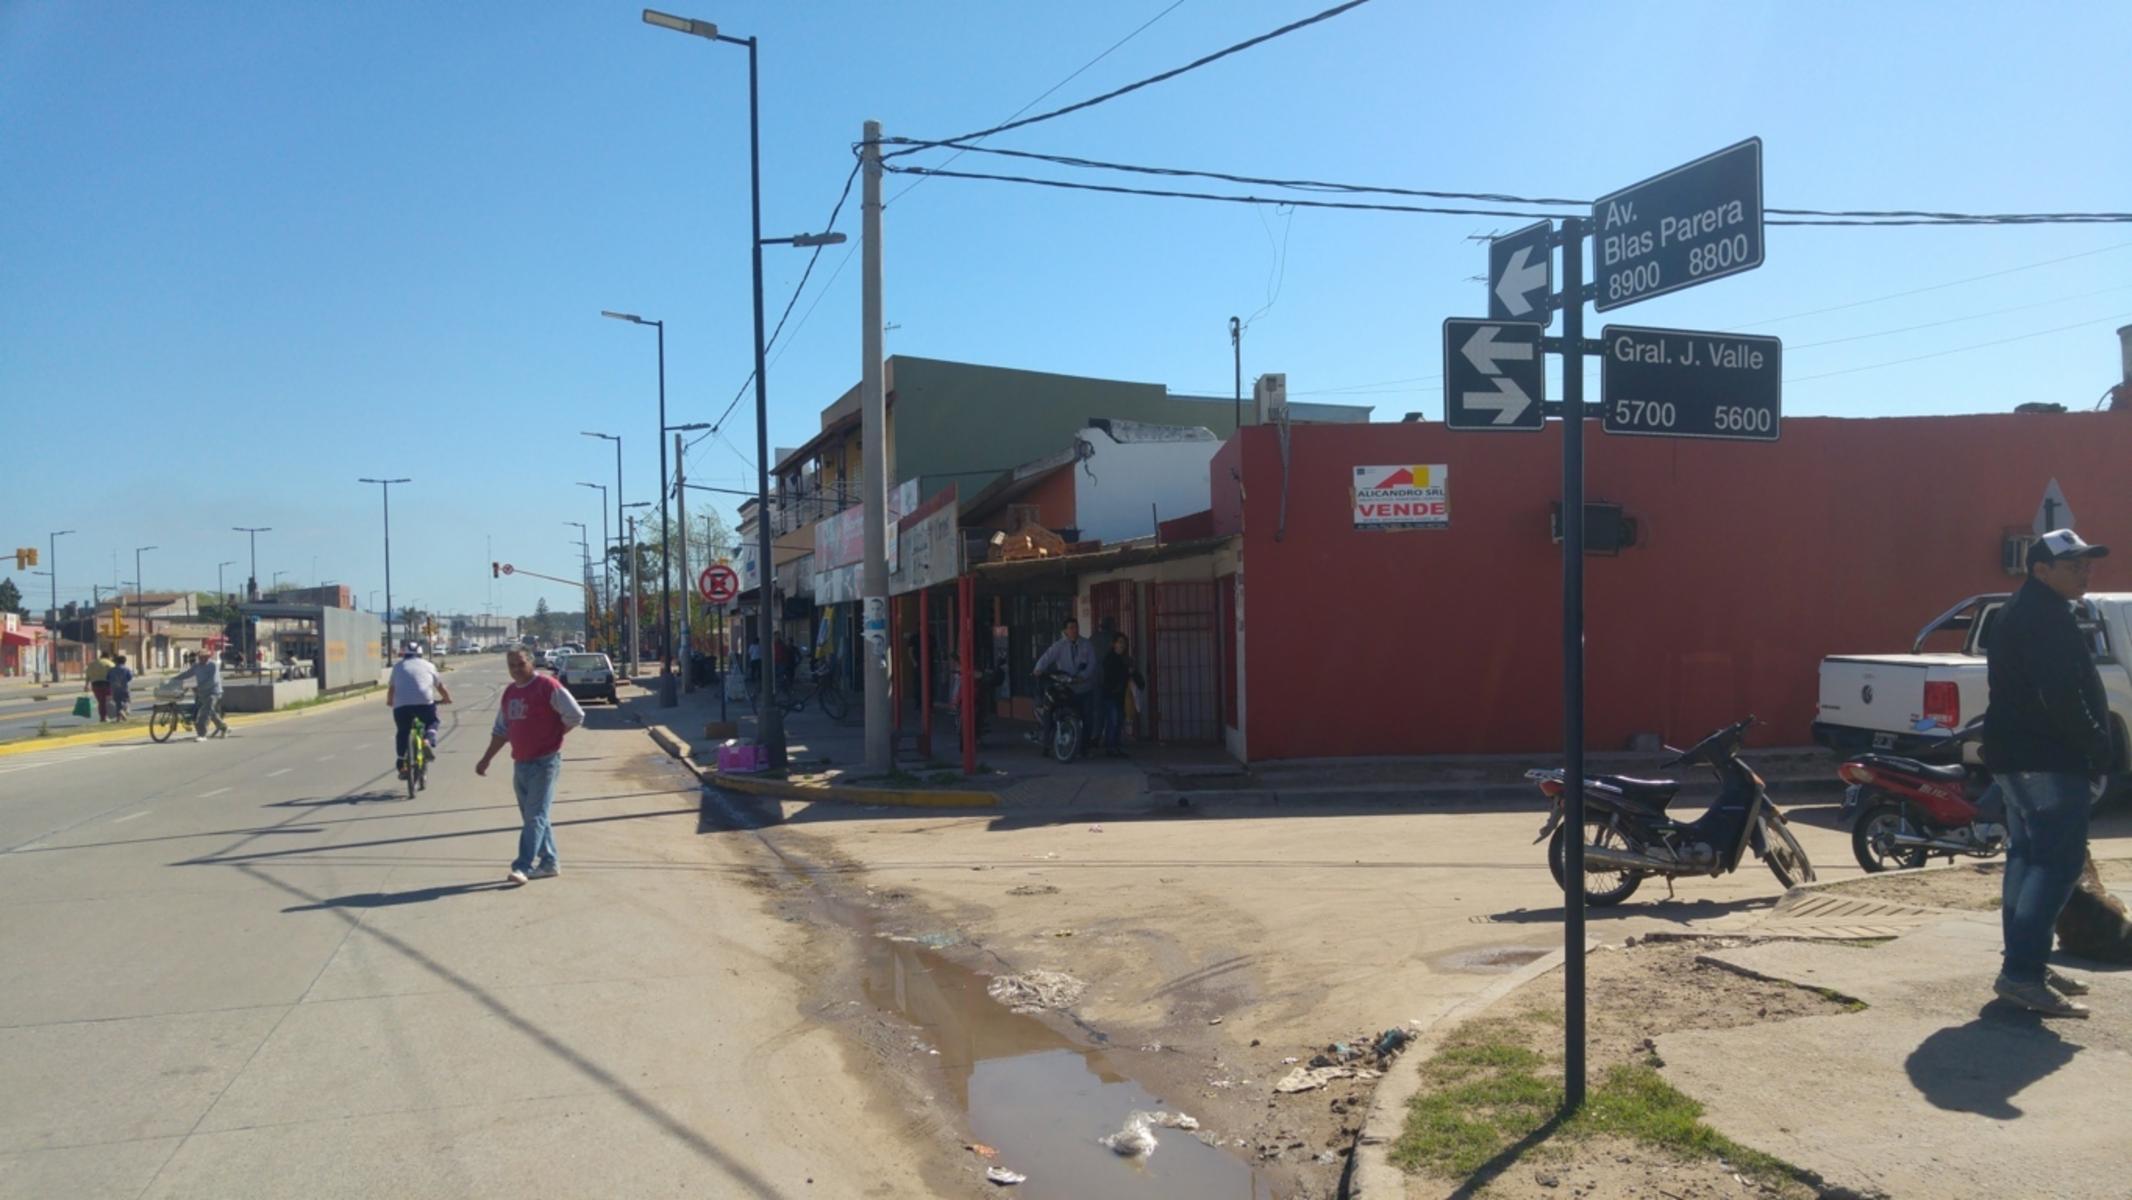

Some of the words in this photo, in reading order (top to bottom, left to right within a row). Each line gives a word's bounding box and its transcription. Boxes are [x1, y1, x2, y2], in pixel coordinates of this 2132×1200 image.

[1604, 200, 1638, 230] Av.
[1604, 230, 1654, 266] Blas
[1660, 200, 1744, 247] Parera
[1608, 261, 1661, 300] 8900
[1688, 233, 1749, 277] 8800
[1614, 336, 1672, 365] Gral.
[1680, 341, 1700, 367] J.
[1708, 342, 1764, 370] Valle
[1615, 399, 1676, 427] 5700
[1714, 405, 1771, 432] 5600
[1358, 488, 1423, 498] ALICANDRO
[1425, 488, 1445, 497] SRL
[1358, 502, 1446, 517] VENDE
